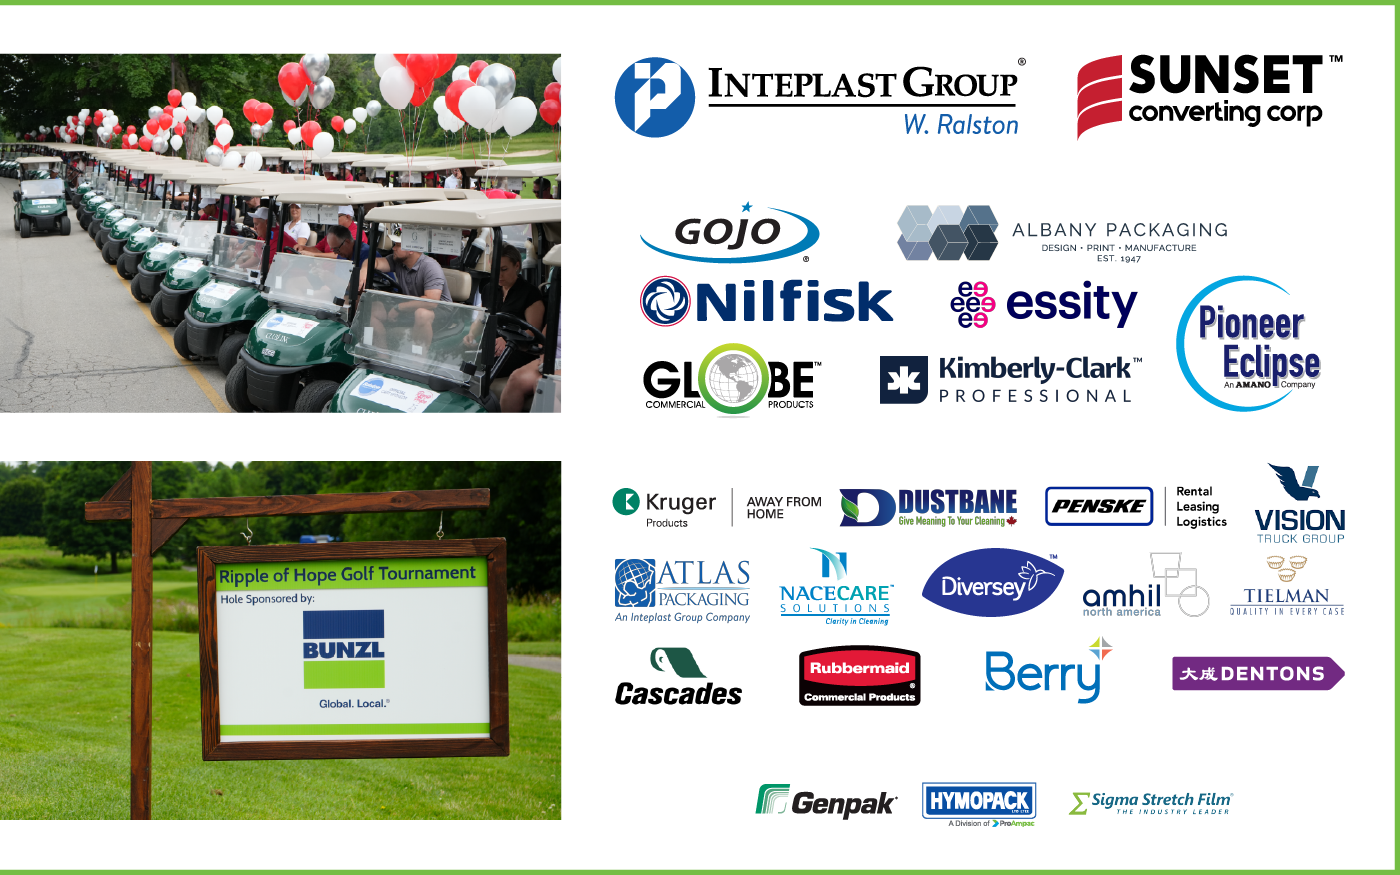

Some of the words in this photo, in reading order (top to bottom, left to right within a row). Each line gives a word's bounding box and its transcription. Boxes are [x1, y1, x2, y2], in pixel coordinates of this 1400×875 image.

[219, 568, 269, 587] Ripple
[273, 568, 289, 583] of
[294, 568, 336, 585] Hope
[341, 566, 374, 581] Golf
[378, 566, 476, 580] Tournament
[221, 594, 243, 604] Hole
[246, 594, 298, 606] Sponsored
[300, 594, 315, 604] by:
[303, 642, 385, 659] BUNZL
[319, 699, 354, 708] Global.
